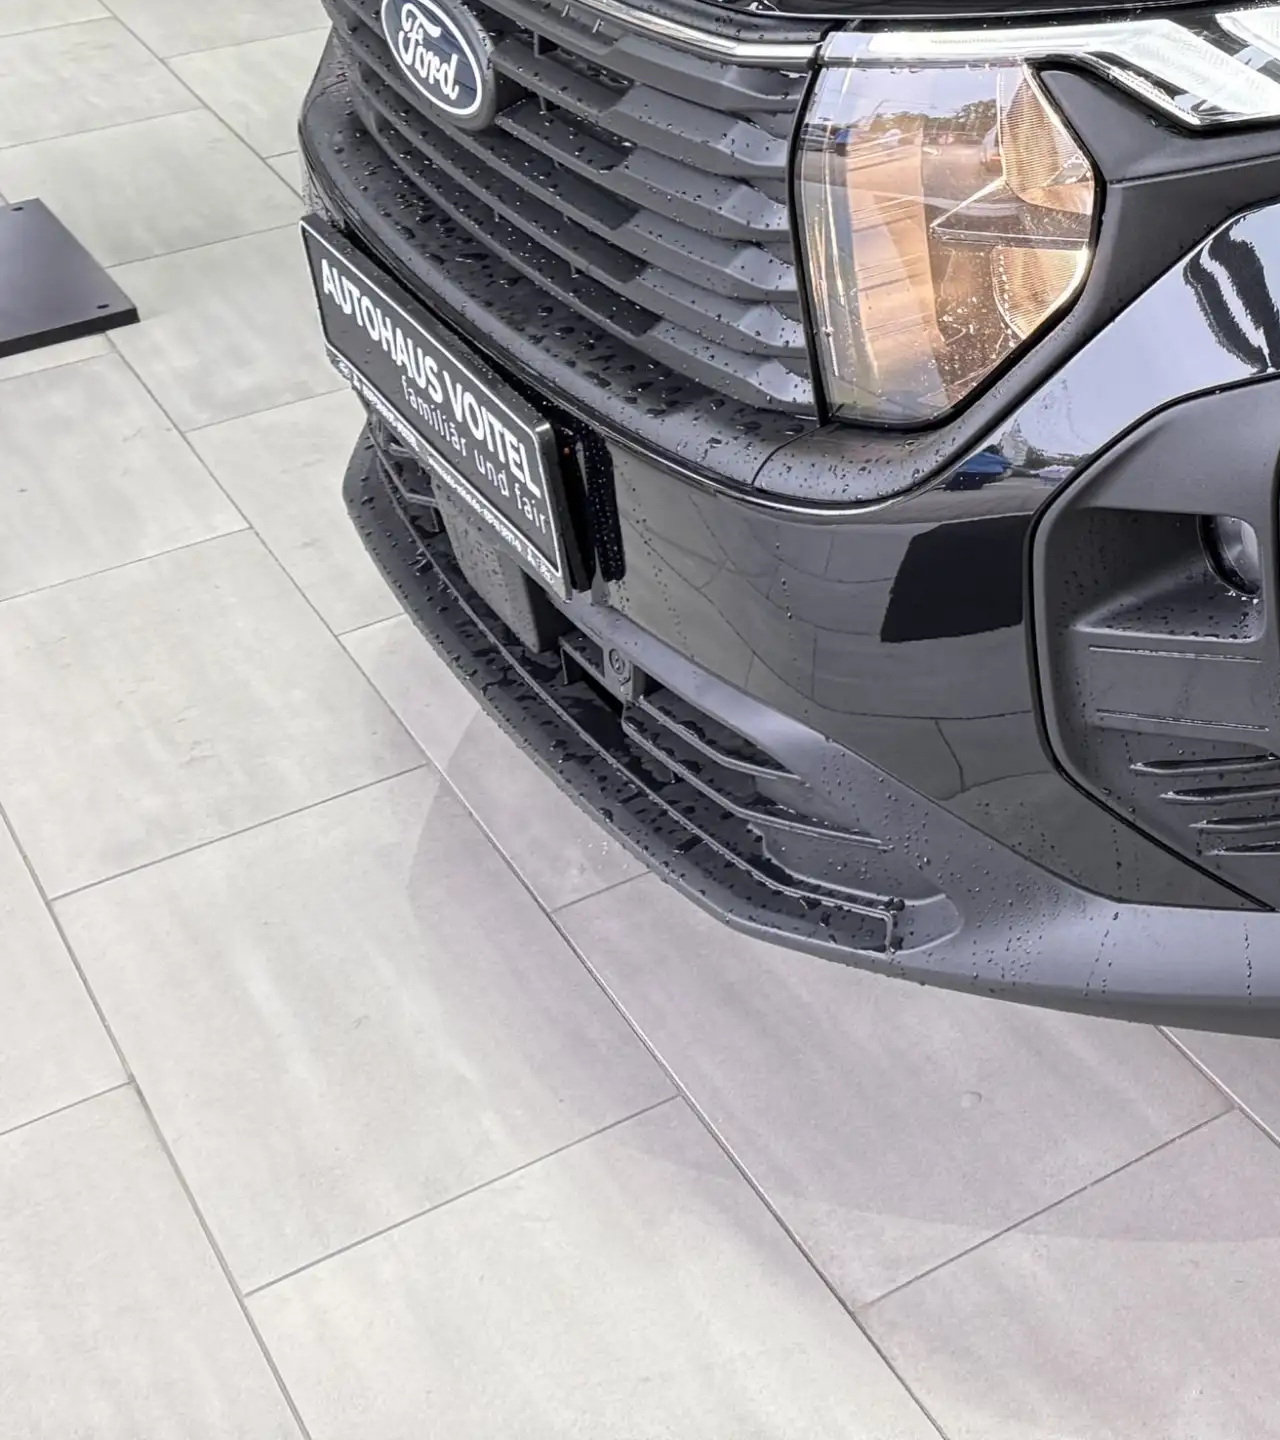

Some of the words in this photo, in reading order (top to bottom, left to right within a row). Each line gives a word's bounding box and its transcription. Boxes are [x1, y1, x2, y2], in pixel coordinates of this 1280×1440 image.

[398, 2, 460, 101] Ford
[321, 258, 443, 404] AUTOHAUS
[443, 369, 541, 499] VOITEL
[401, 375, 468, 457] familiär
[474, 448, 510, 498] und
[514, 482, 549, 534] fair
